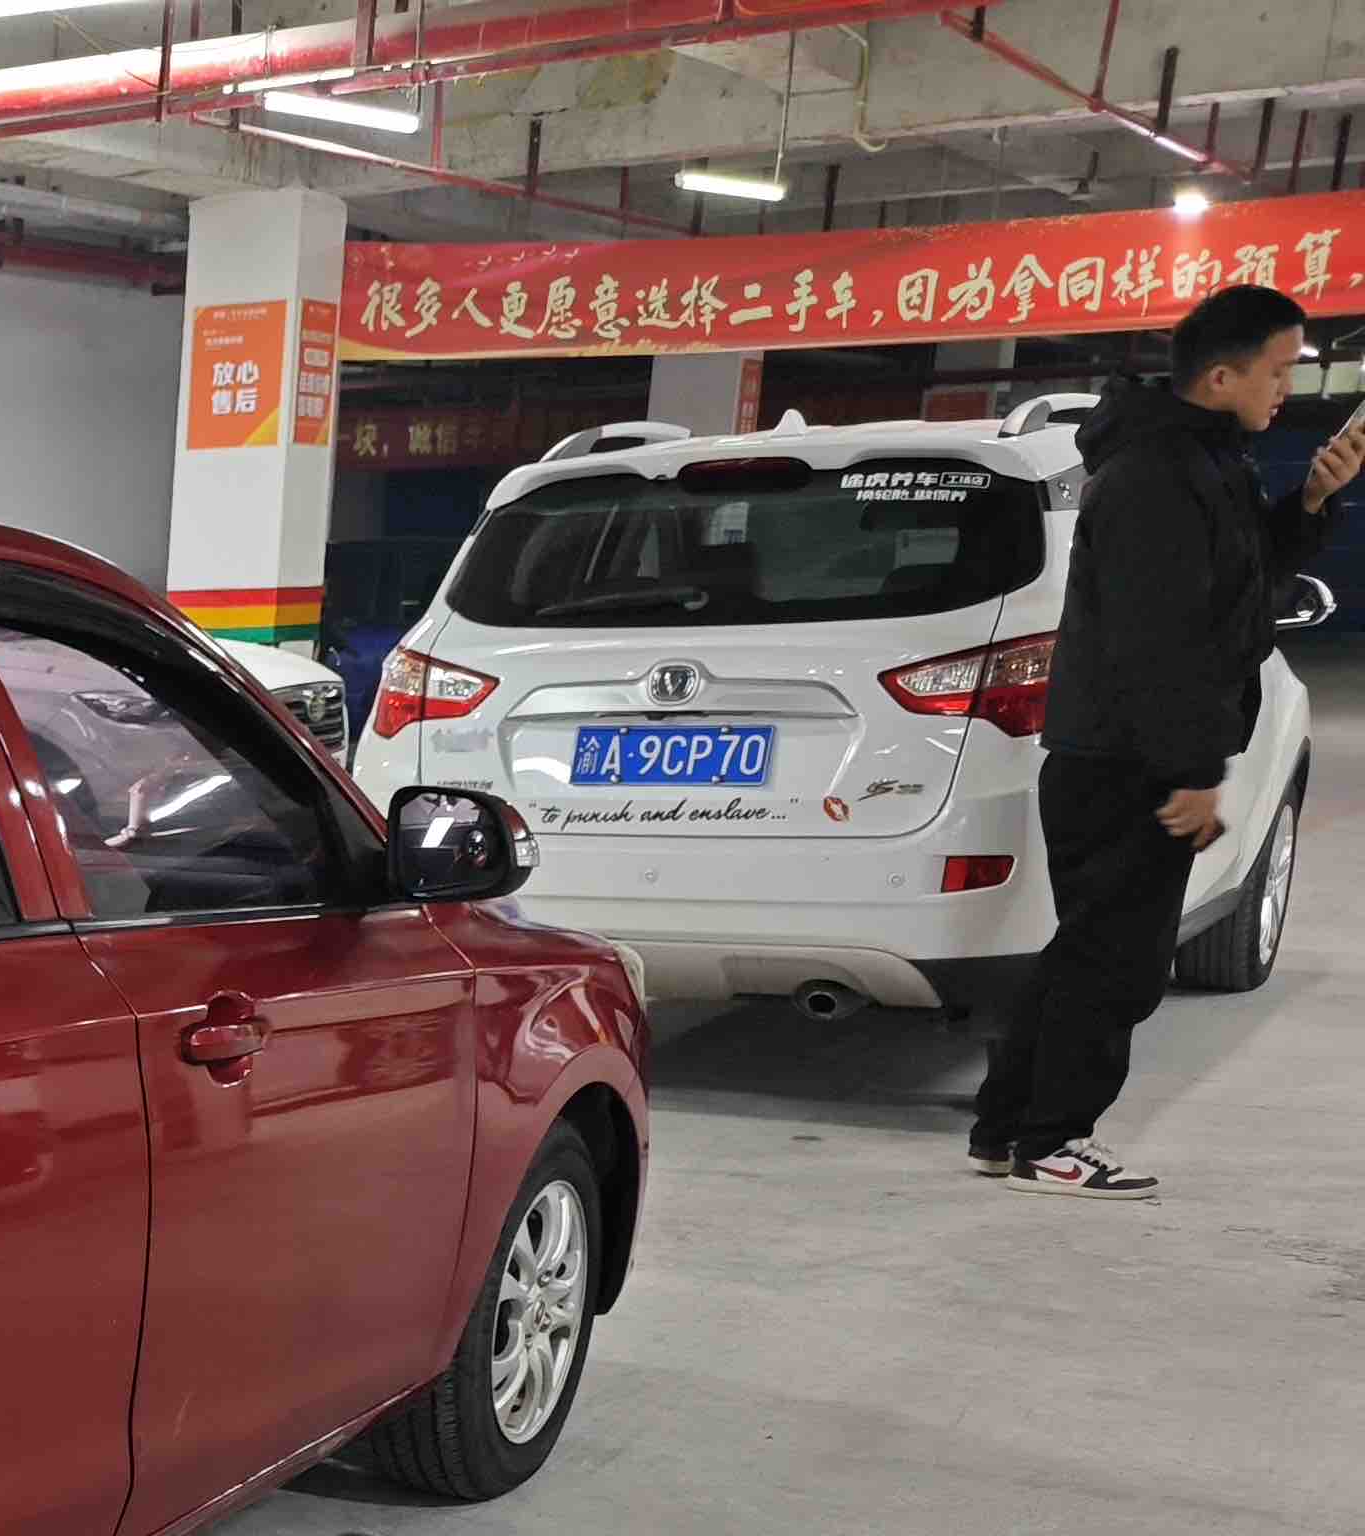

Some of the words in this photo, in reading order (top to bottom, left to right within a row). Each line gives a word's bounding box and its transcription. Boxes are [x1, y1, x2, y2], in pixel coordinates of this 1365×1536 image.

[212, 360, 261, 386] 放心
[560, 799, 634, 832] punish
[639, 798, 688, 823] and
